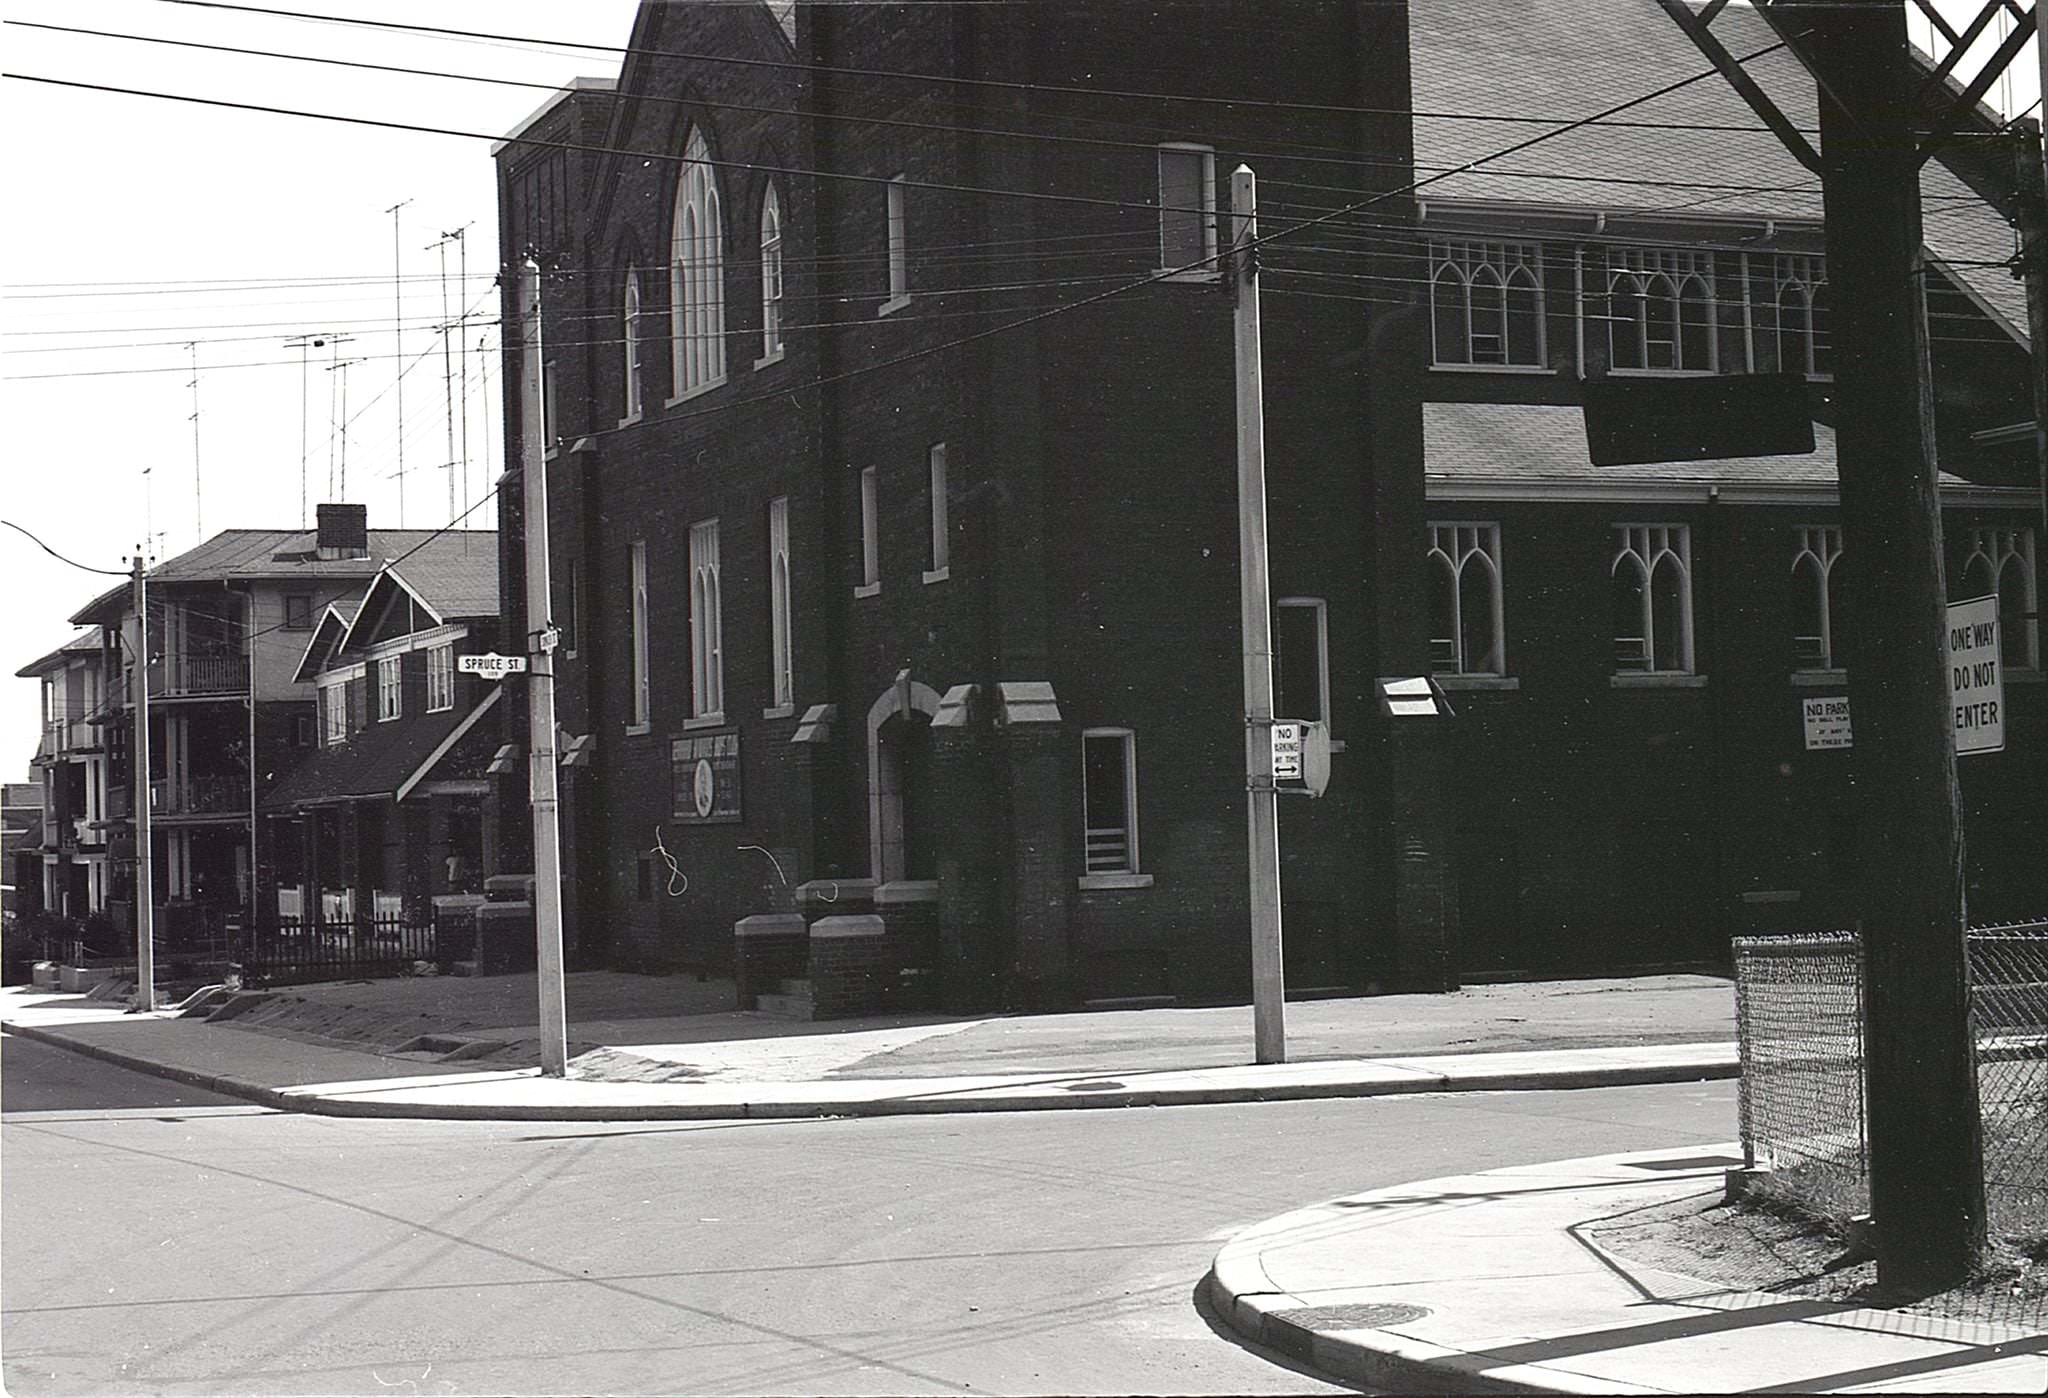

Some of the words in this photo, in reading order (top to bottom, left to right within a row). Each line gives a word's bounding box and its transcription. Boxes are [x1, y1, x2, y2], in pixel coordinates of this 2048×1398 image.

[1950, 626, 1972, 652] ONE
[1973, 621, 1995, 648] WAY
[465, 658, 502, 670] SPRUCE
[1953, 665, 1970, 691] DO
[1973, 661, 1995, 688] NOT
[1807, 703, 1823, 716] NO
[1955, 701, 1998, 730] ENTER
[1278, 728, 1292, 739] NO
